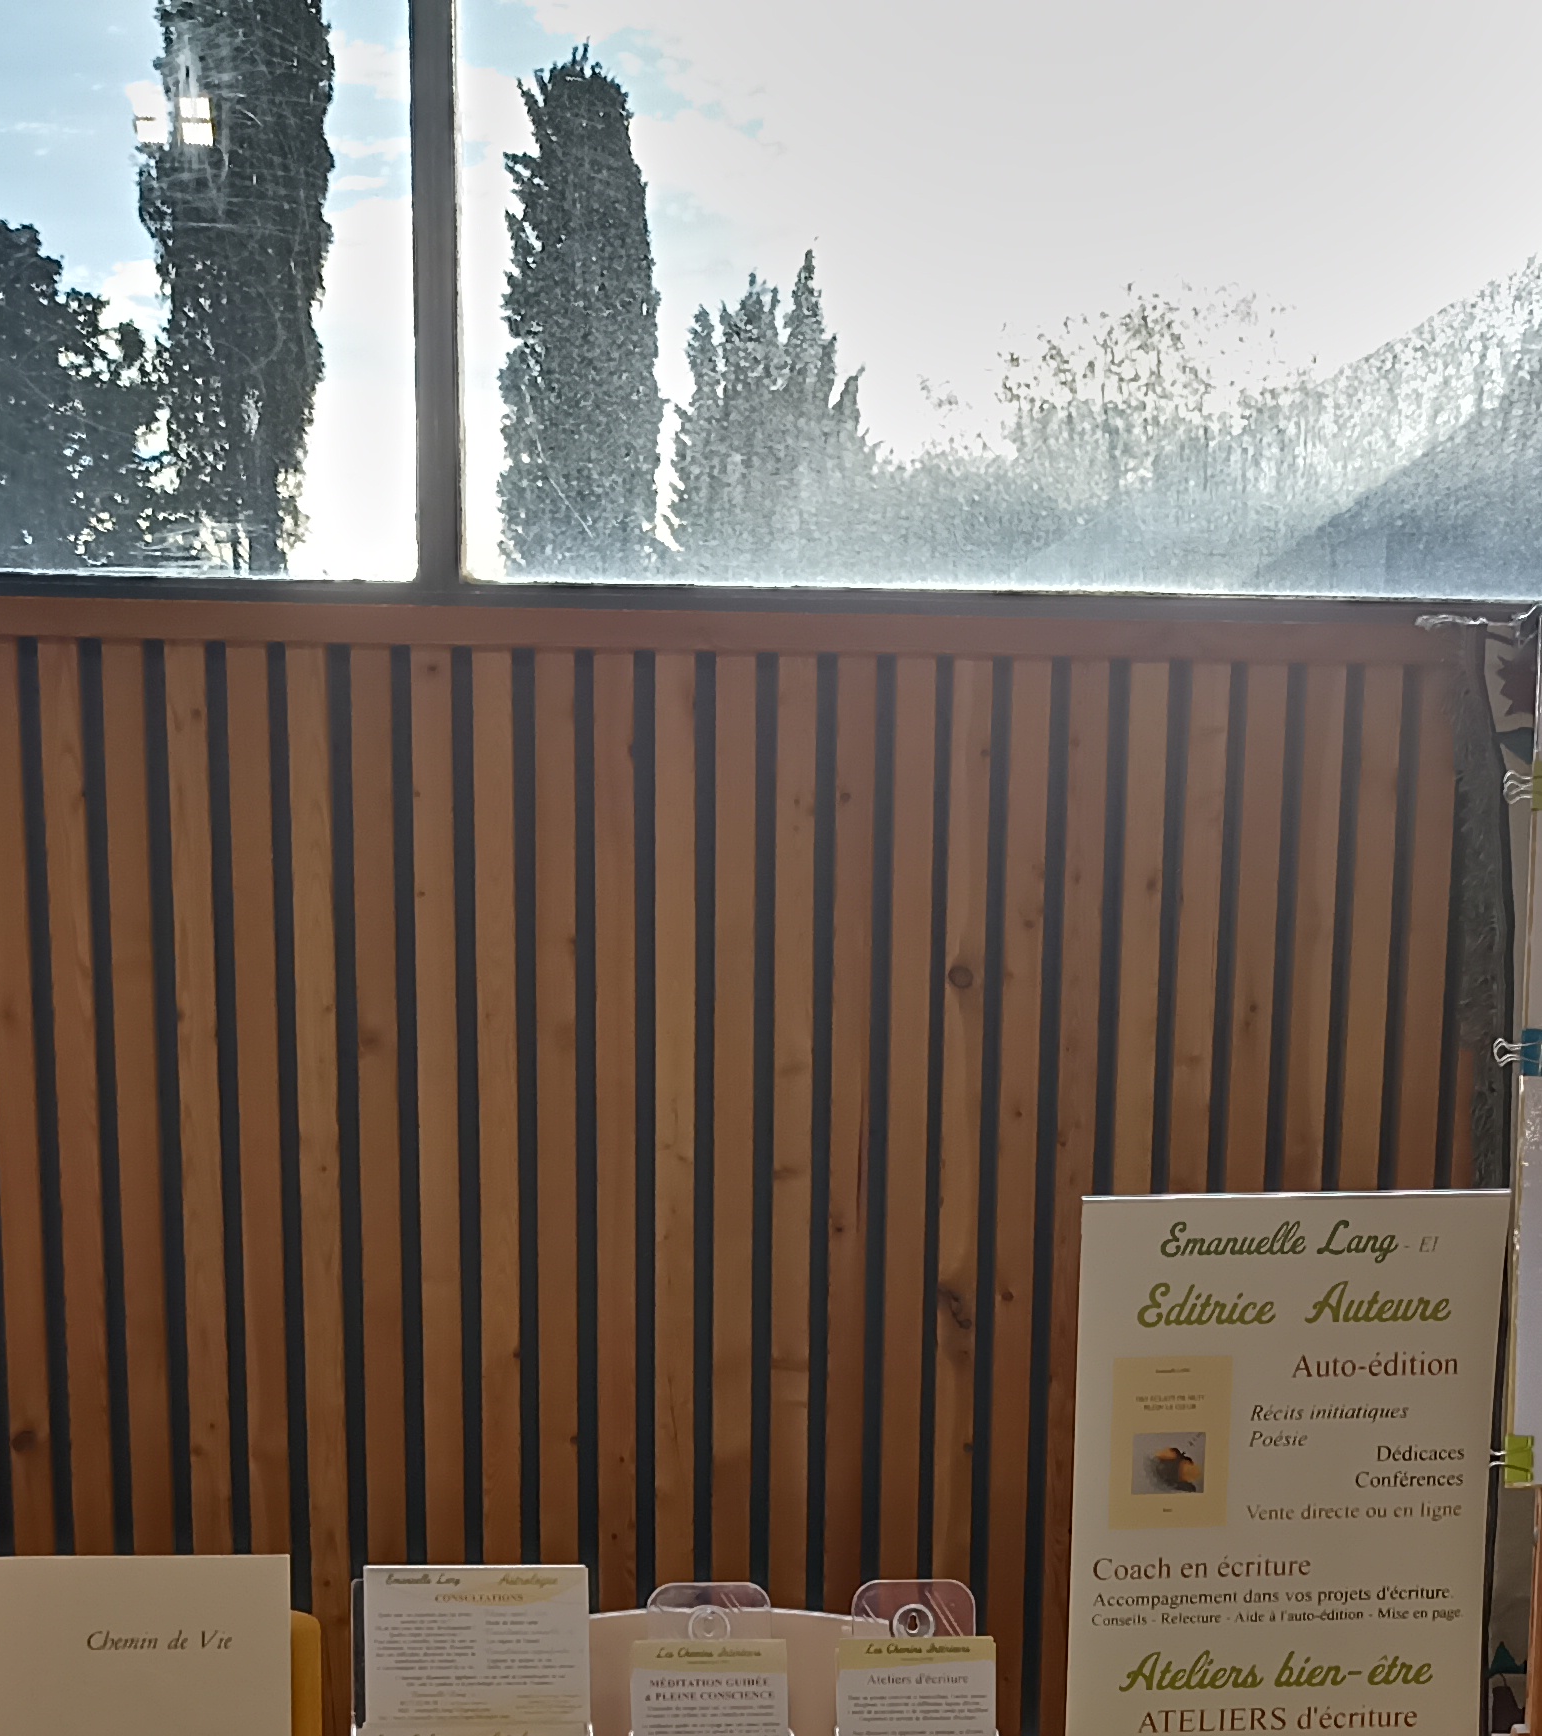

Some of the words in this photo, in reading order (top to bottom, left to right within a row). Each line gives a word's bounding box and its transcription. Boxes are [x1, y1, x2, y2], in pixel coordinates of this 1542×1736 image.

[1160, 1221, 1306, 1258] Emanuelle
[1317, 1220, 1398, 1263] Lang
[1137, 1282, 1276, 1328] Editrice
[1305, 1280, 1452, 1324] Auteure
[1291, 1350, 1458, 1379] Auto-édition
[1251, 1404, 1303, 1422] Récits
[1309, 1404, 1409, 1423] initiatiques
[1249, 1430, 1308, 1448] Poésie
[1377, 1445, 1465, 1463] Dédicaces
[1355, 1471, 1464, 1489] Conférences
[1246, 1505, 1293, 1521] Vente
[1300, 1503, 1359, 1520] directe
[1366, 1505, 1386, 1518] ou
[1393, 1504, 1413, 1517] en
[1420, 1502, 1462, 1523] ligne
[1092, 1557, 1172, 1581] Coach
[1179, 1560, 1208, 1578] en
[1217, 1554, 1311, 1578] écriture
[1092, 1590, 1238, 1609] Accompagnement
[1243, 1589, 1279, 1604] dans
[1285, 1590, 1313, 1603] vos
[1317, 1587, 1371, 1606] projets
[1091, 1613, 1147, 1627] Conseils
[1161, 1612, 1221, 1625] Relecture
[1235, 1611, 1264, 1624] Aide
[1269, 1609, 1276, 1622] à
[1280, 1608, 1364, 1622] l'auto-édition
[1377, 1607, 1409, 1620] Mise
[1413, 1608, 1428, 1619] en
[87, 1629, 158, 1651] Chemin
[167, 1630, 188, 1649] de
[200, 1630, 233, 1649] Vie
[867, 1674, 911, 1685] Ateliers
[916, 1673, 969, 1684] d'écriture
[1119, 1650, 1263, 1692] Ateliers
[655, 1692, 696, 1701] PLEINE
[700, 1690, 775, 1699] CONSCIENCE
[1137, 1707, 1287, 1734] ATELIERS
[1296, 1706, 1419, 1730] d'écriture
